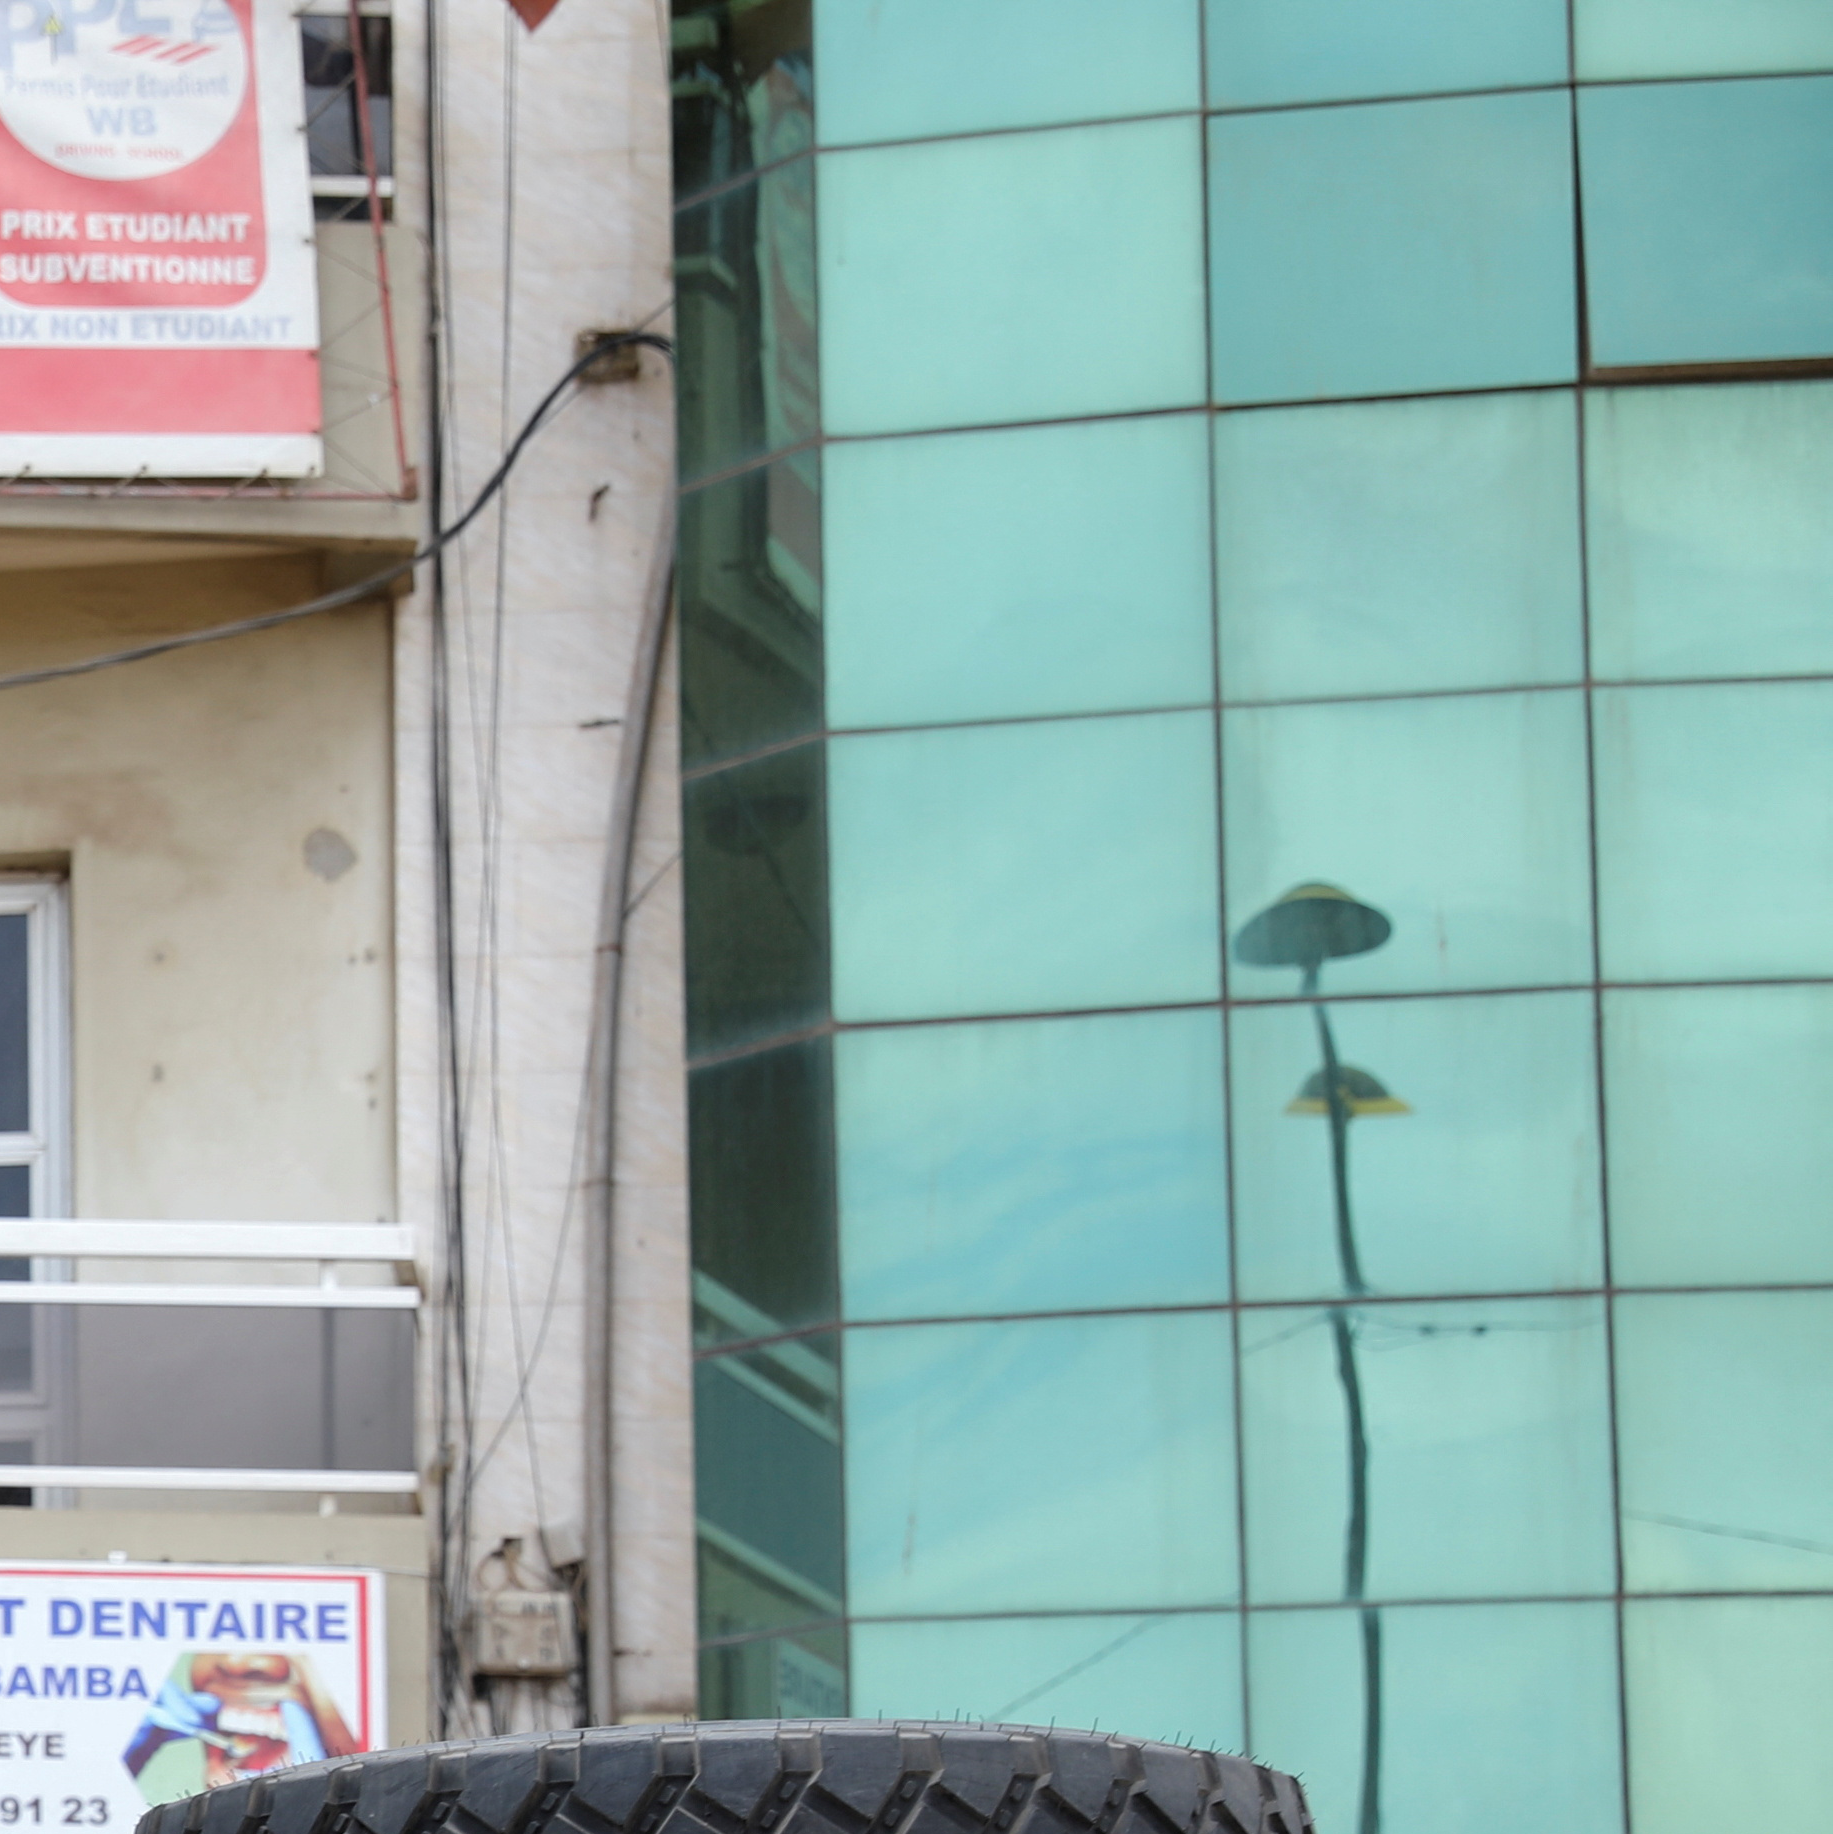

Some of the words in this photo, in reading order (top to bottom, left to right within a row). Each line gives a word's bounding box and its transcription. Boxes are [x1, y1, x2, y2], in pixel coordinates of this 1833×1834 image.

[87, 106, 158, 137] WB
[0, 209, 78, 240] PRIX
[84, 213, 251, 243] ETUDIANT
[49, 313, 120, 341] NON
[131, 313, 292, 341] ETUDIANT
[50, 1600, 349, 1641] DENTAIRE
[0, 1796, 42, 1824] 91
[63, 1797, 110, 1826] 23
